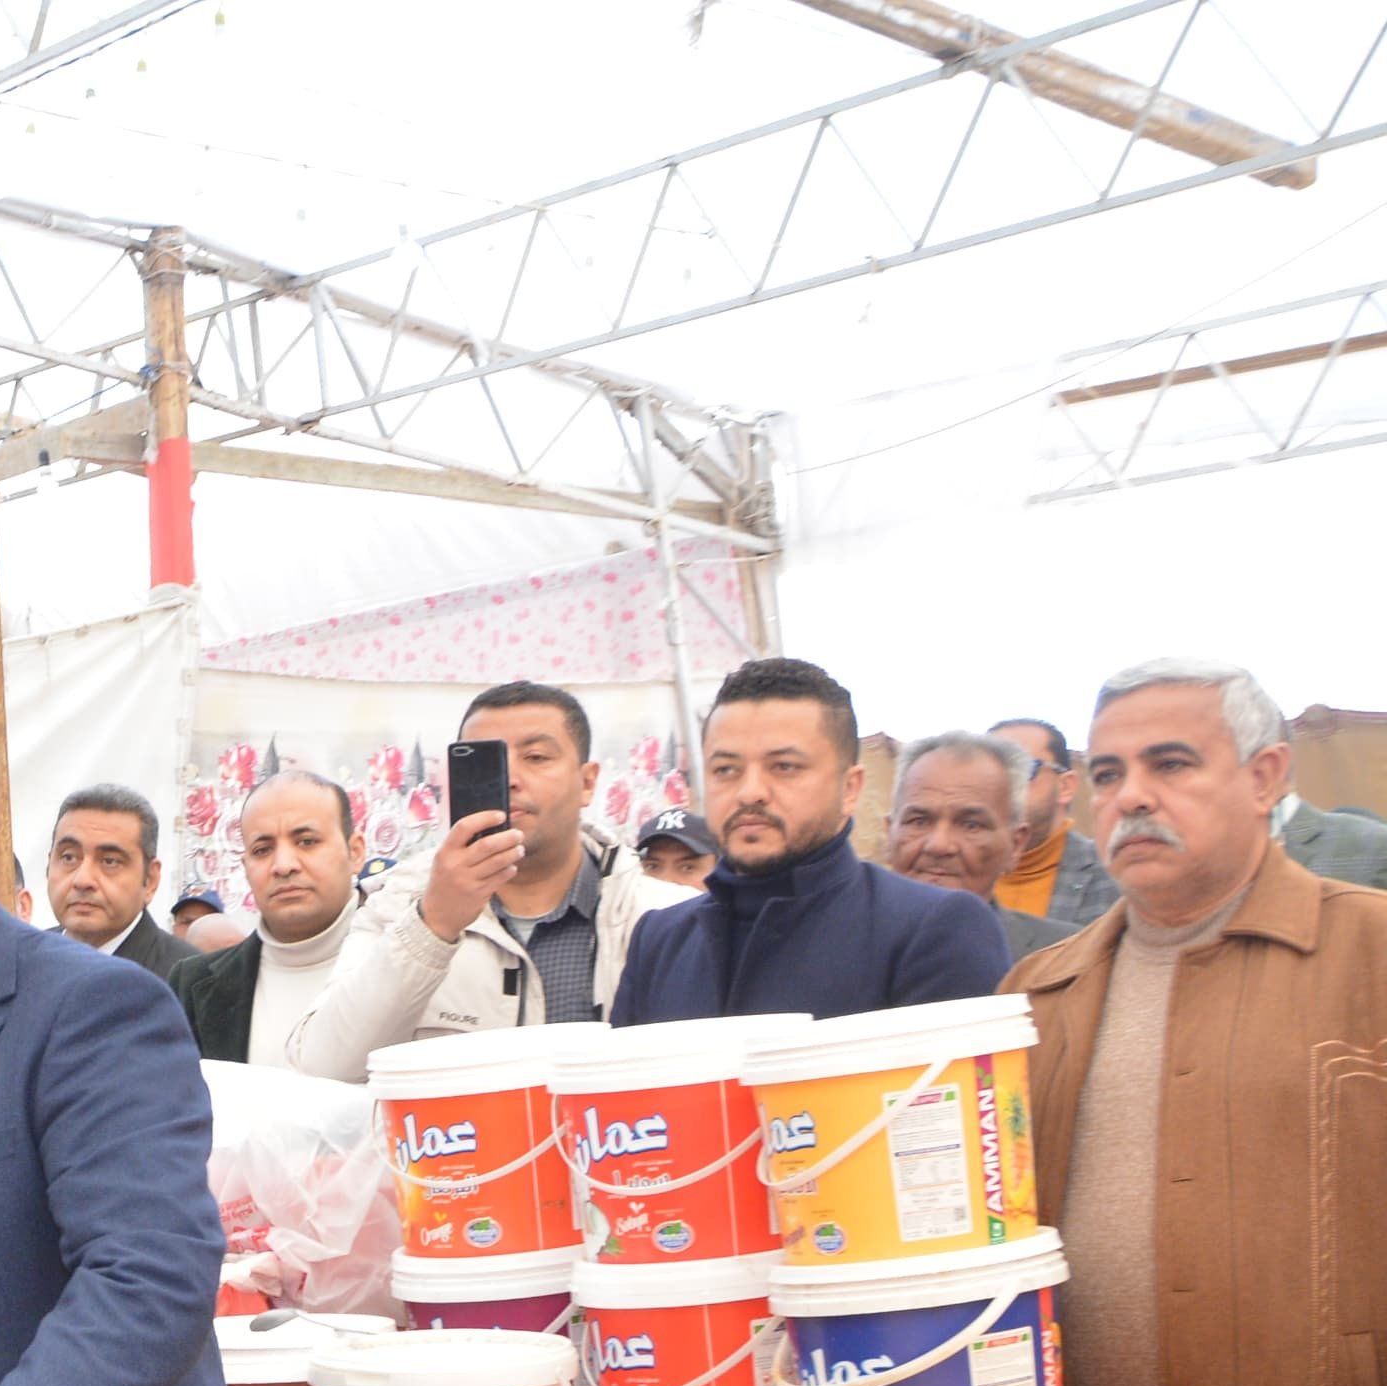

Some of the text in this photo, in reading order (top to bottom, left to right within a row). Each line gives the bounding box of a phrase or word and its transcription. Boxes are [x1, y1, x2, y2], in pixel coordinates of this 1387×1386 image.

[396, 1112, 478, 1175] عمان
[575, 1105, 668, 1175] عمان
[978, 1088, 1005, 1214] AMMAN
